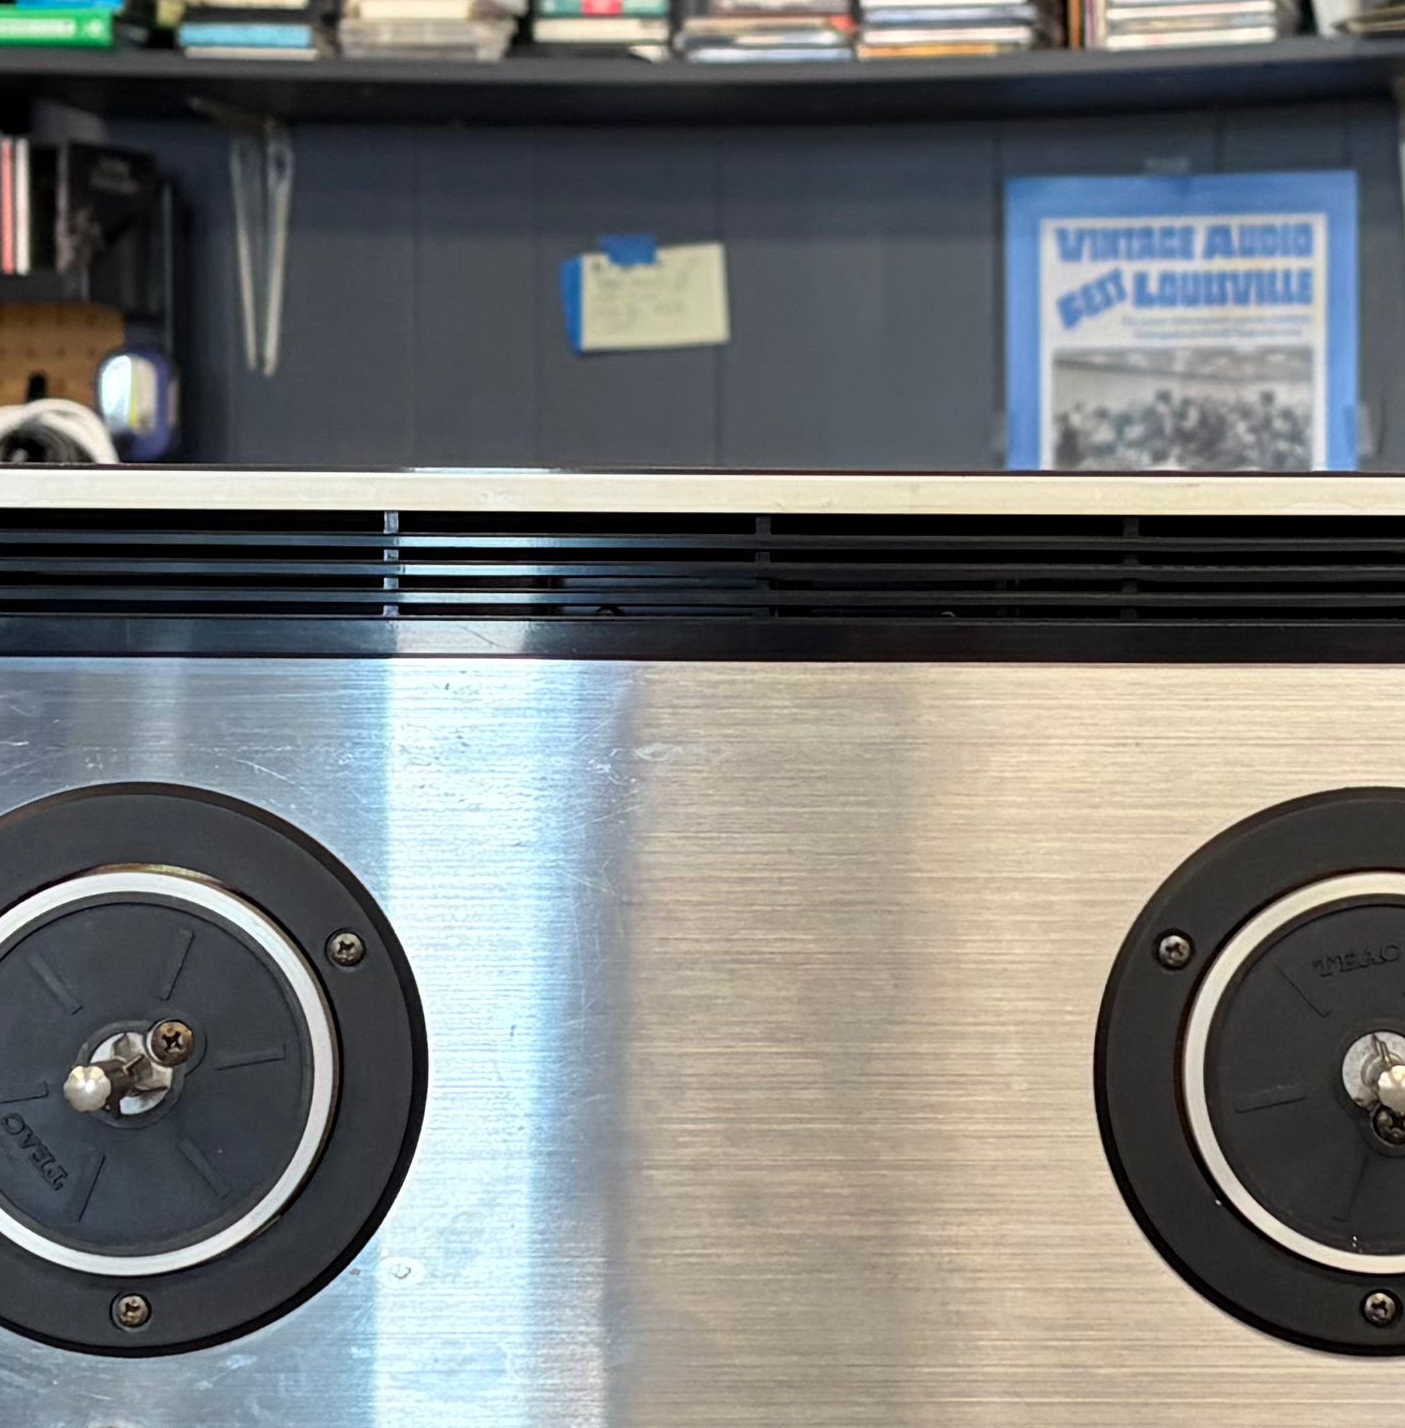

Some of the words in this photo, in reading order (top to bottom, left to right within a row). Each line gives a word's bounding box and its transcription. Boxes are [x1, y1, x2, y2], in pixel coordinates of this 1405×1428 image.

[1054, 225, 1196, 263] VINTAGE
[1201, 222, 1314, 260] AUDIO
[1132, 268, 1314, 308] LOUISVILLE
[0, 1110, 70, 1192] TEAC
